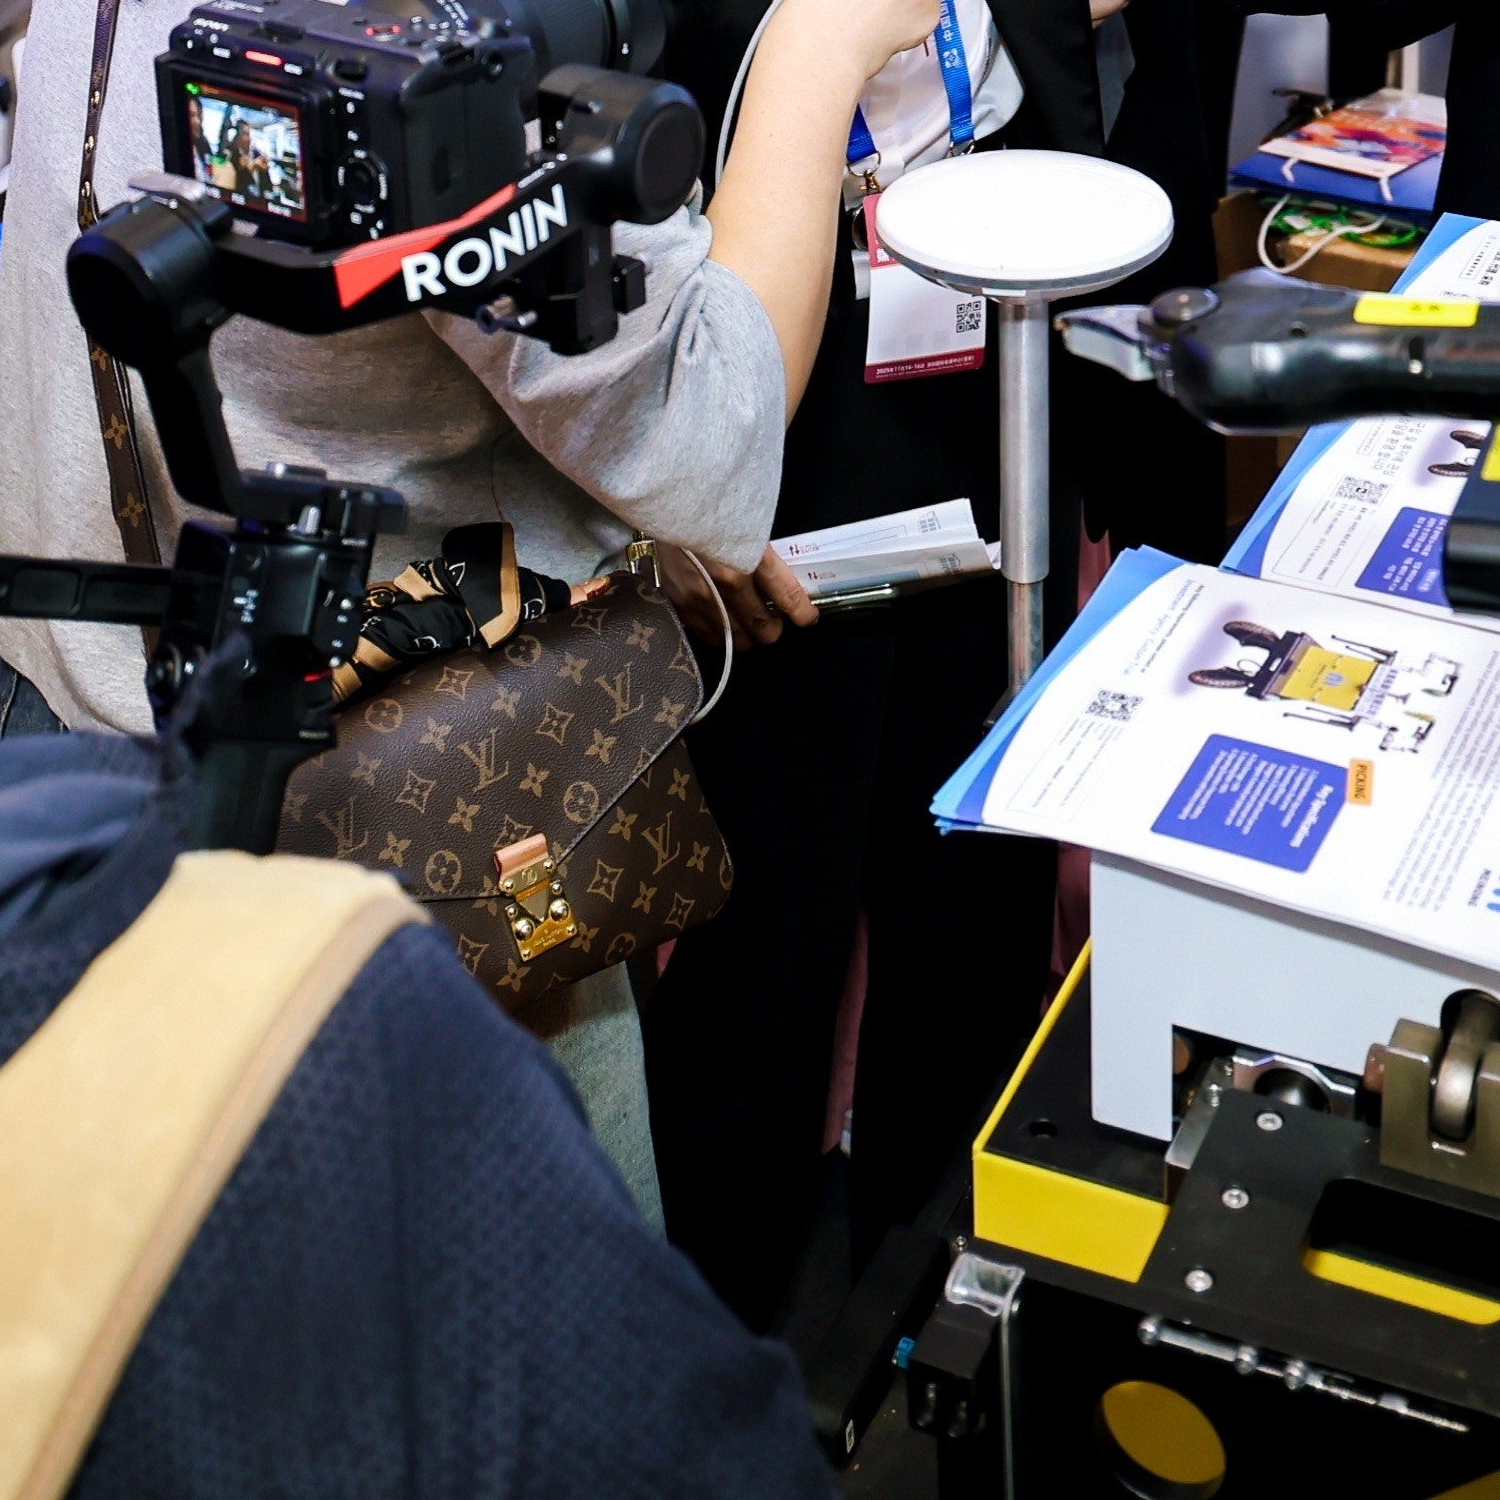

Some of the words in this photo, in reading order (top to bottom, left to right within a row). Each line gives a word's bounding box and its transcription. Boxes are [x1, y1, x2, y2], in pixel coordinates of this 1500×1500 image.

[401, 183, 568, 303] RONIN
[1353, 764, 1367, 799] PICKING
[1286, 797, 1328, 850] Specifications
